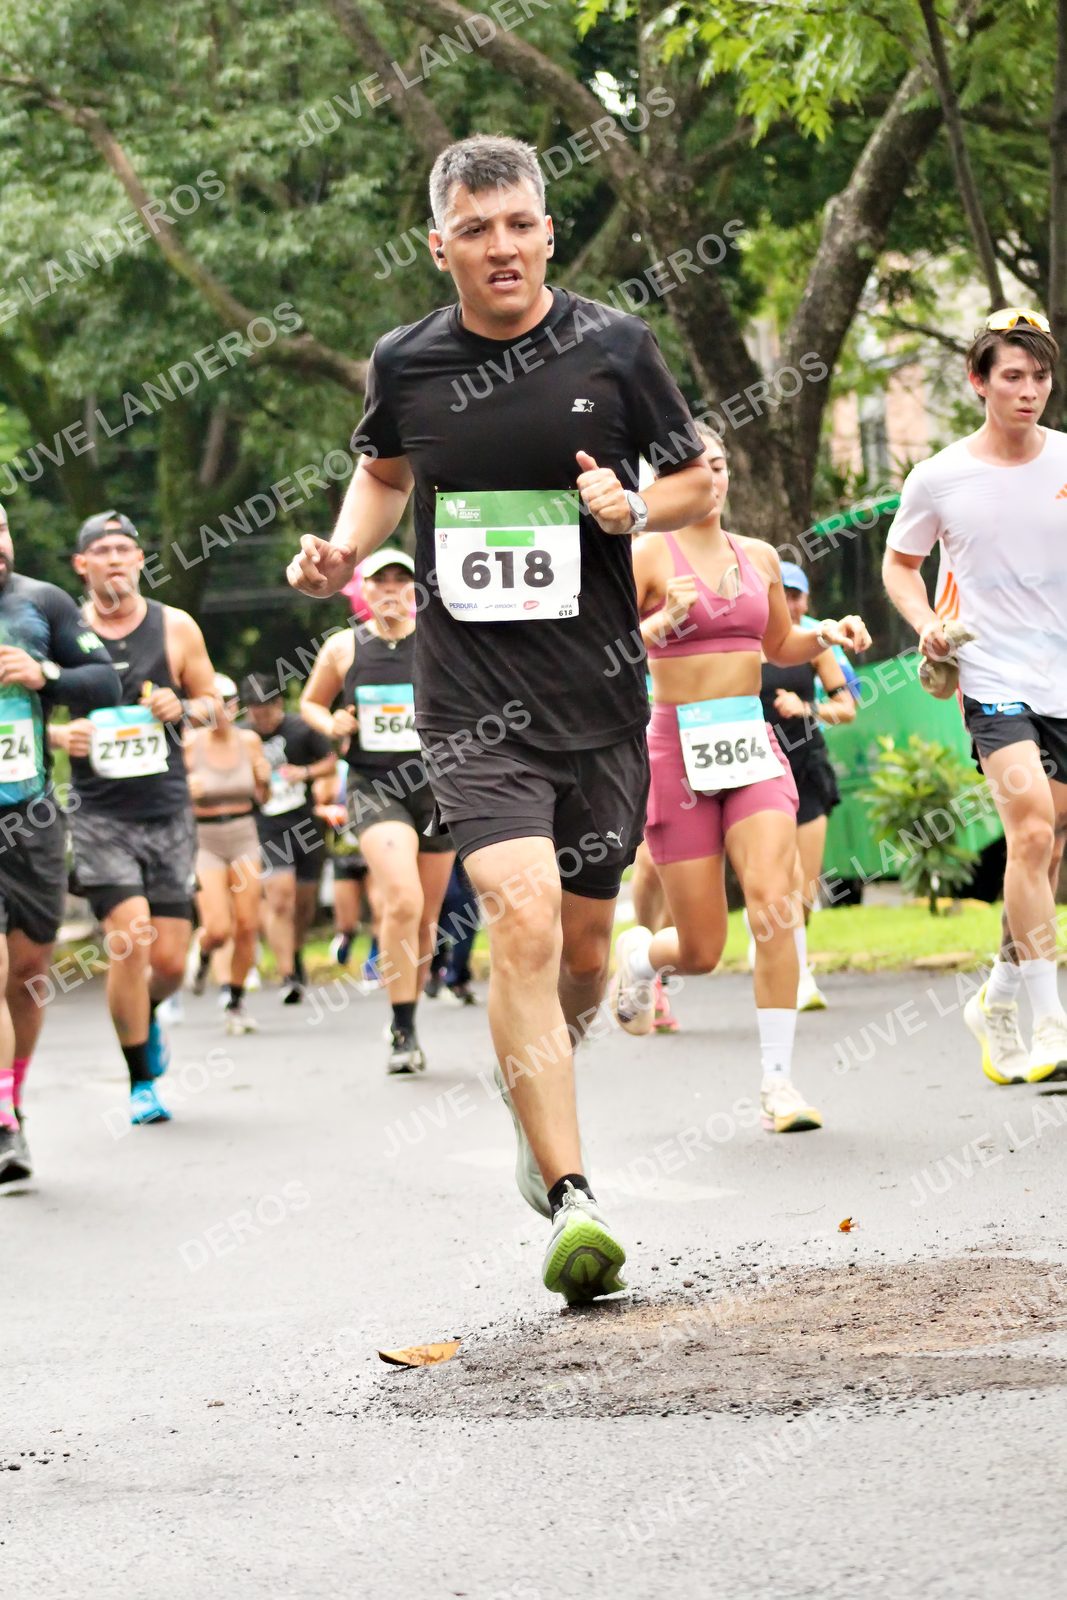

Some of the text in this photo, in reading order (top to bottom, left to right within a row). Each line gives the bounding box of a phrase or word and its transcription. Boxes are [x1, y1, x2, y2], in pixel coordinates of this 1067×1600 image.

[462, 550, 554, 589] 618
[98, 735, 160, 761] 2737
[692, 737, 767, 769] 3864
